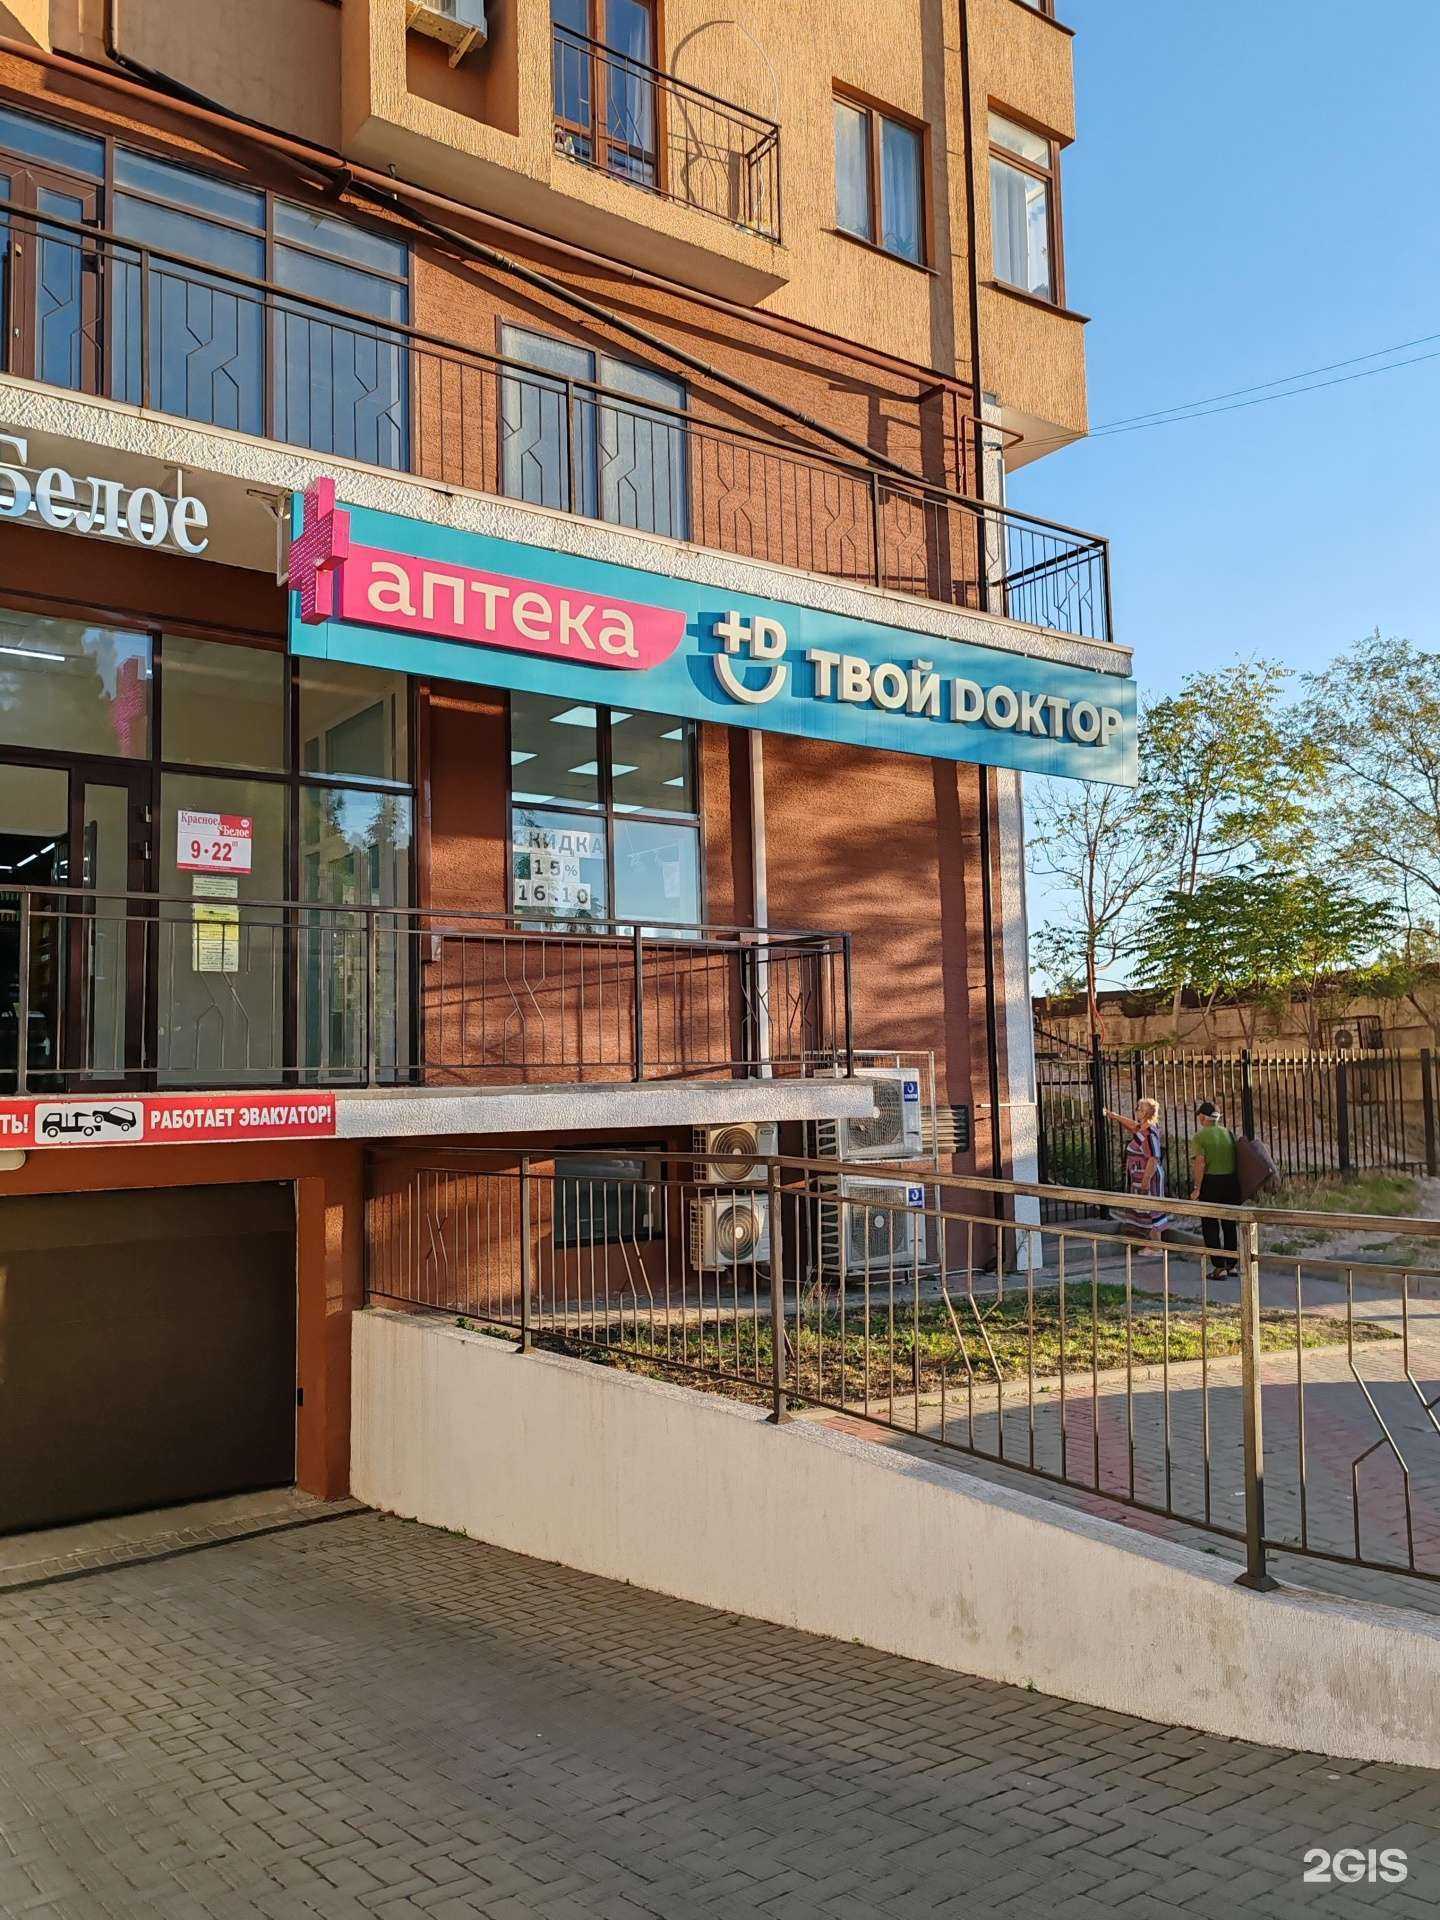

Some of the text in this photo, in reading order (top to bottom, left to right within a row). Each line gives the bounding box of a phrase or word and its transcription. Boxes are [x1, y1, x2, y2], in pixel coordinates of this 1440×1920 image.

[367, 561, 639, 658] аптека
[805, 647, 940, 718] ТВОЙ
[181, 811, 219, 826] Красное
[223, 825, 250, 838] Белое
[534, 859, 578, 878] 15%
[518, 884, 588, 905] 16.10
[151, 1108, 235, 1129] РАБОТАЕТ
[238, 1105, 332, 1127] ЭВАКУАТОР!
